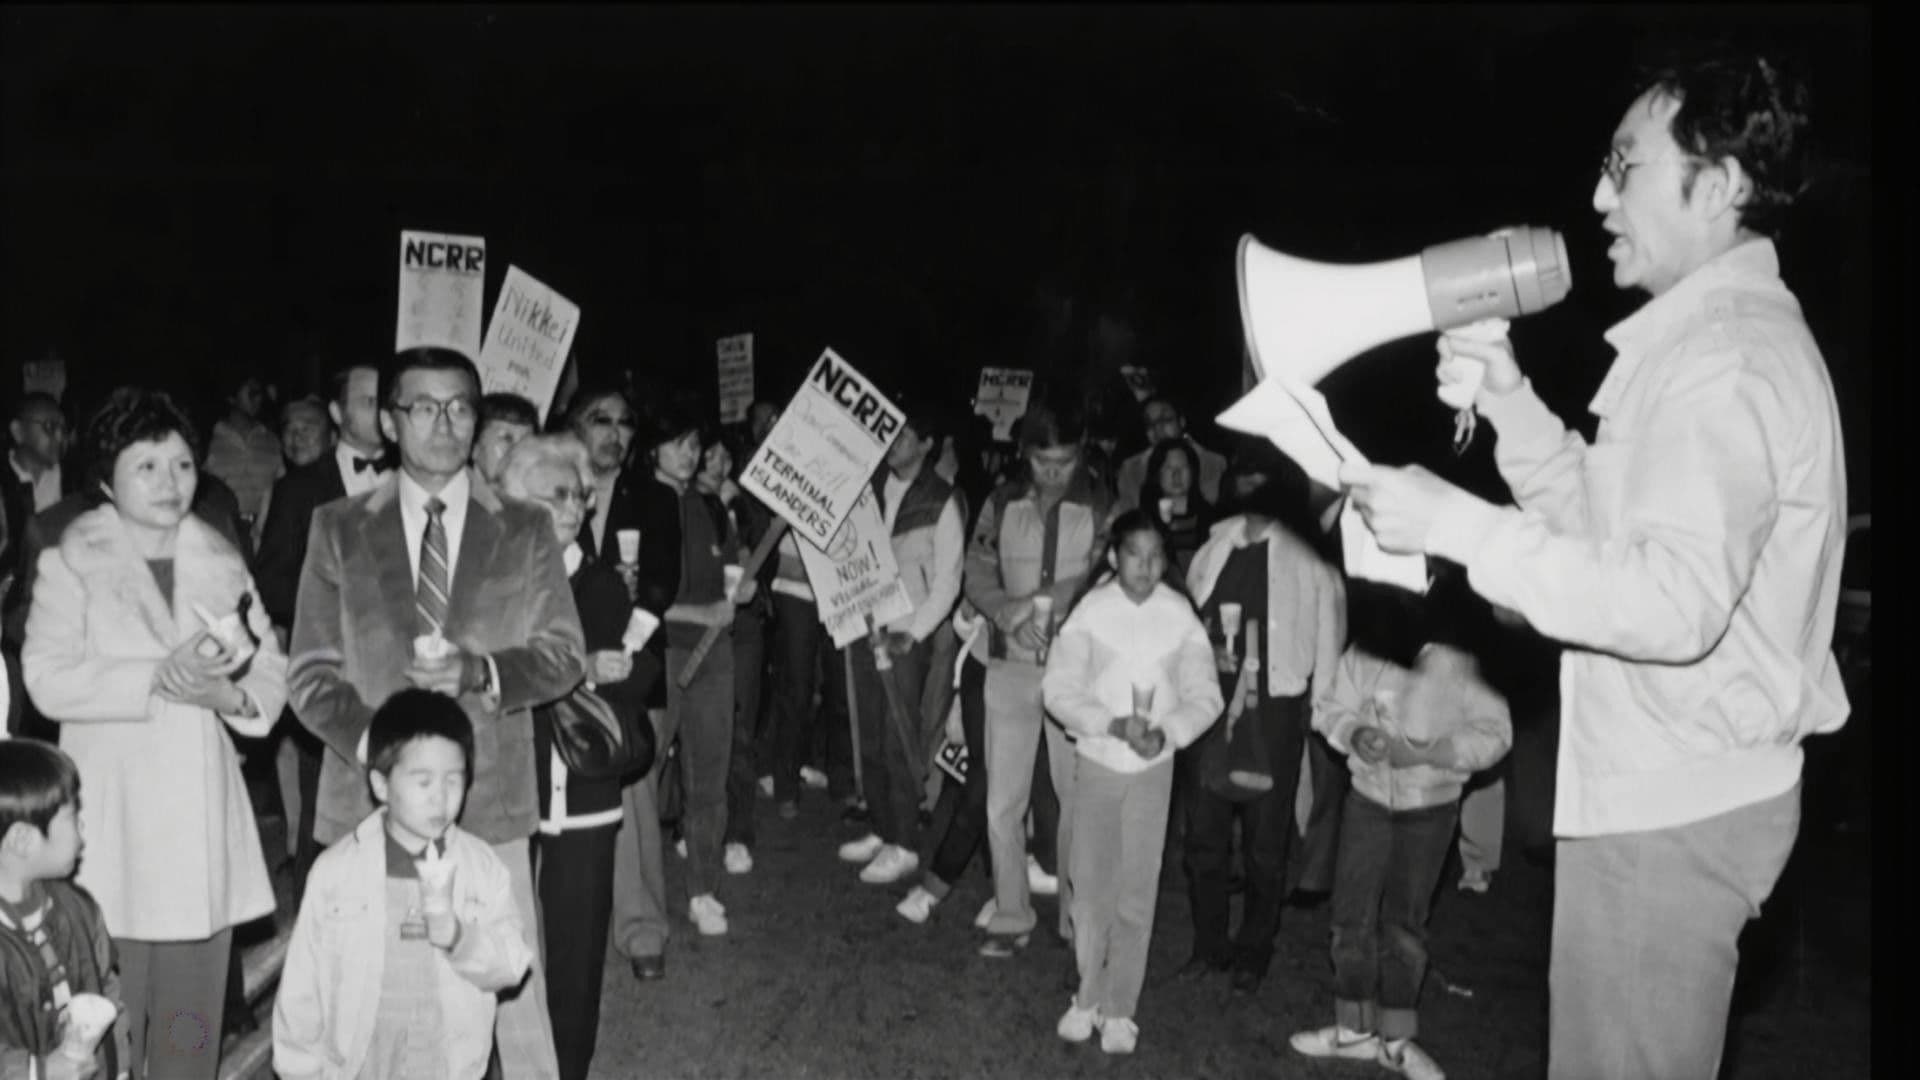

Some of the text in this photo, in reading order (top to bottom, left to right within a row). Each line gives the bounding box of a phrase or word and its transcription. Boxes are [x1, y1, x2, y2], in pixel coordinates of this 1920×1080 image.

[405, 239, 484, 272] NCRR
[503, 286, 570, 345] Nikkei
[813, 357, 898, 443] NCRR
[750, 464, 832, 538] ISLANDERS
[764, 447, 836, 519] TERMINAL
